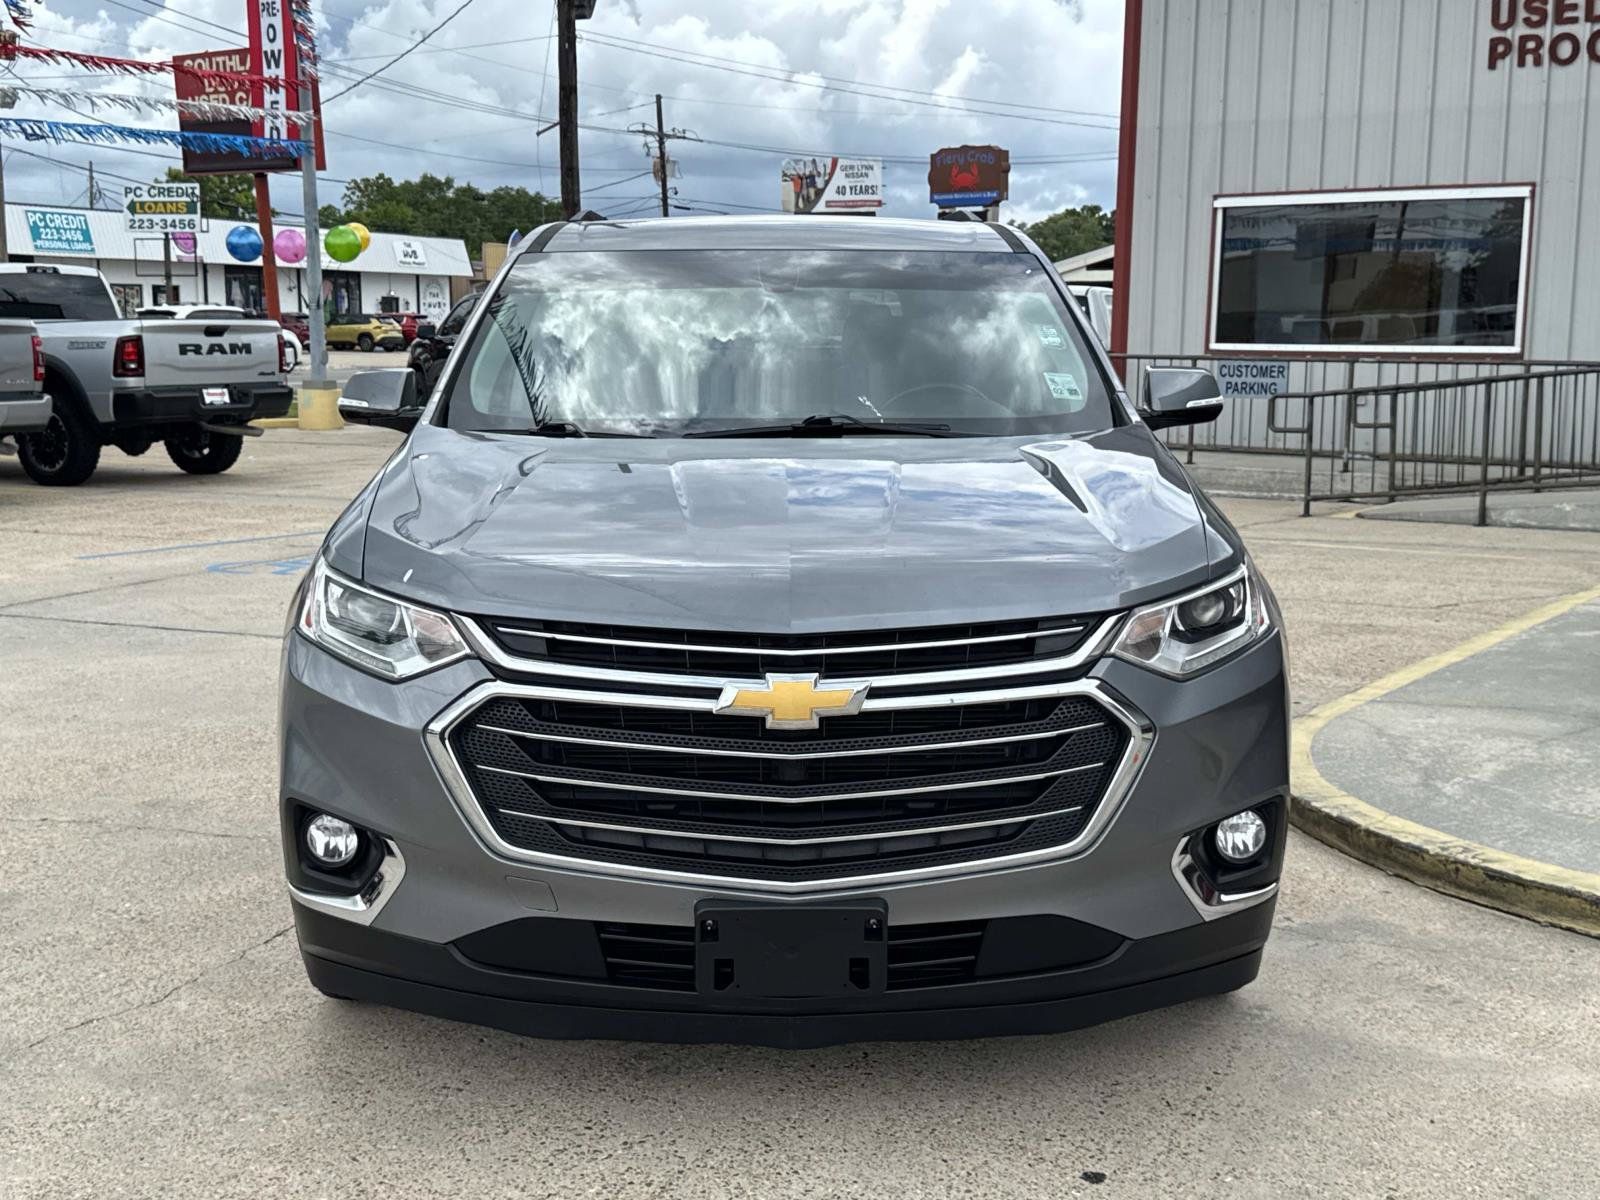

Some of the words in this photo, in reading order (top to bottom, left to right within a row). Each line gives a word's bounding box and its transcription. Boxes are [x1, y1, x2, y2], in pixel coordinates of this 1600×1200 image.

[124, 187, 143, 199] PC
[147, 186, 198, 199] CREDIT
[836, 185, 847, 196] 40
[849, 184, 879, 196] YEARS!
[135, 202, 187, 213] LOANS
[27, 212, 45, 226] PC
[46, 213, 87, 230] CREDIT
[128, 218, 196, 230] 223-3456
[40, 228, 84, 241] 223-3456
[178, 342, 252, 356] RAM
[1219, 364, 1286, 379] CUSTOMER
[1225, 381, 1278, 395] PARKING
